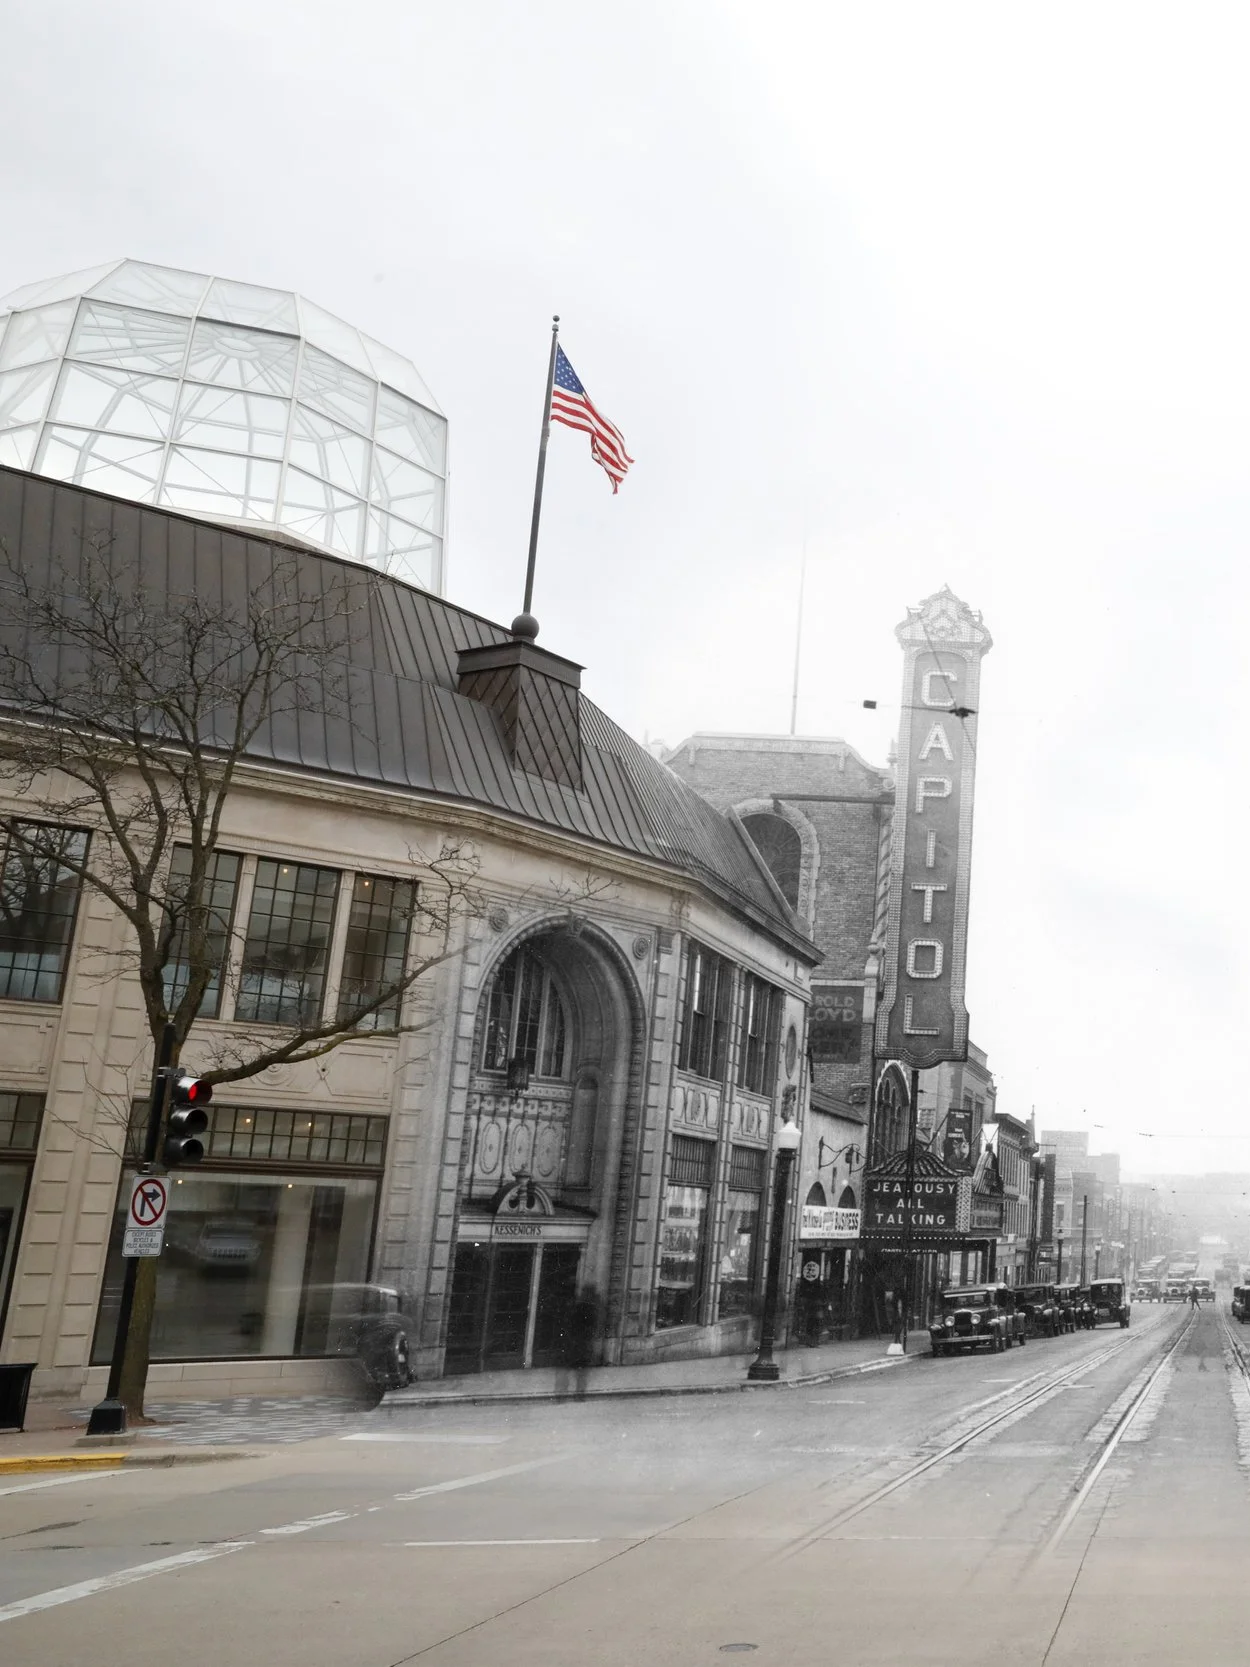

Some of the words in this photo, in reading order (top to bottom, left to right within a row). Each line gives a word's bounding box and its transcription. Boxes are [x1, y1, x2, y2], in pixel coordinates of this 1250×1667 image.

[904, 671, 957, 1035] CAPITOL
[873, 1182, 956, 1194] JEAOUSY
[494, 1223, 542, 1236] KESSENICH'S
